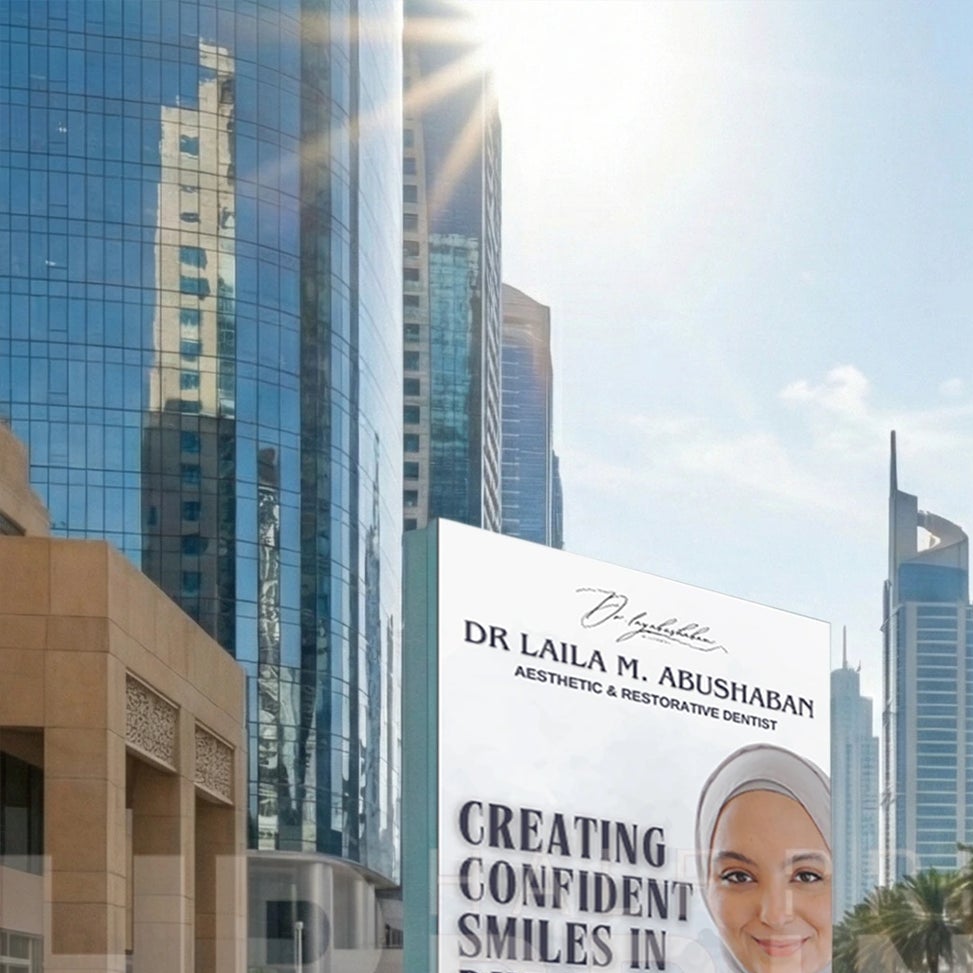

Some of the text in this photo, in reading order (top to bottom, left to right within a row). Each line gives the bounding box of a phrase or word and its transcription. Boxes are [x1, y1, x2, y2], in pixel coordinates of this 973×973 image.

[464, 619, 815, 719] DR LAILA M. ABUSHABAN
[514, 665, 778, 731] AESTHETIC & RESTORATIVE DENTIST
[459, 800, 666, 868] CREATING
[459, 857, 694, 922] CONFIDENT
[457, 912, 667, 971] SMILES IN
